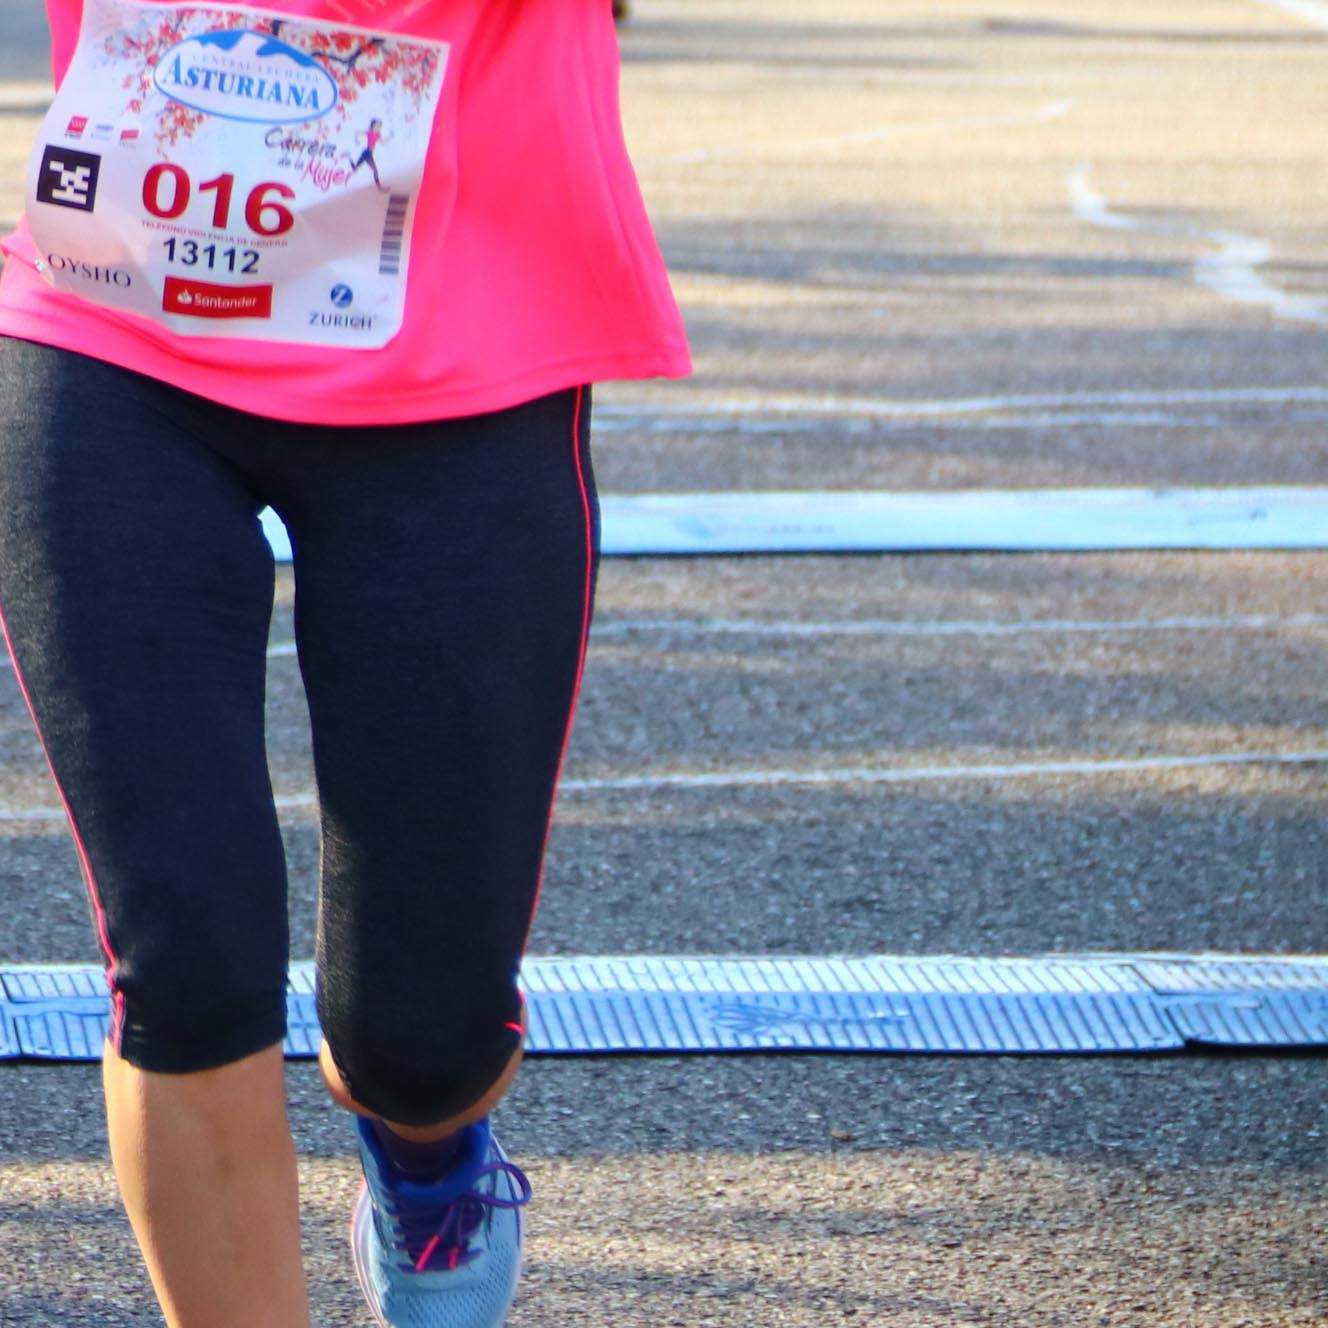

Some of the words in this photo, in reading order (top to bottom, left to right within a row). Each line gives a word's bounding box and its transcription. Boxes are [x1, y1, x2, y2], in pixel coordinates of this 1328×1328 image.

[162, 53, 321, 110] ASTURIANA
[265, 127, 337, 158] Carrera
[302, 157, 353, 192] Mujer
[142, 162, 296, 237] 016
[47, 253, 132, 289] OYSHO
[163, 236, 260, 274] 13112
[194, 292, 257, 309] Santander
[308, 311, 372, 331] ZURICH
